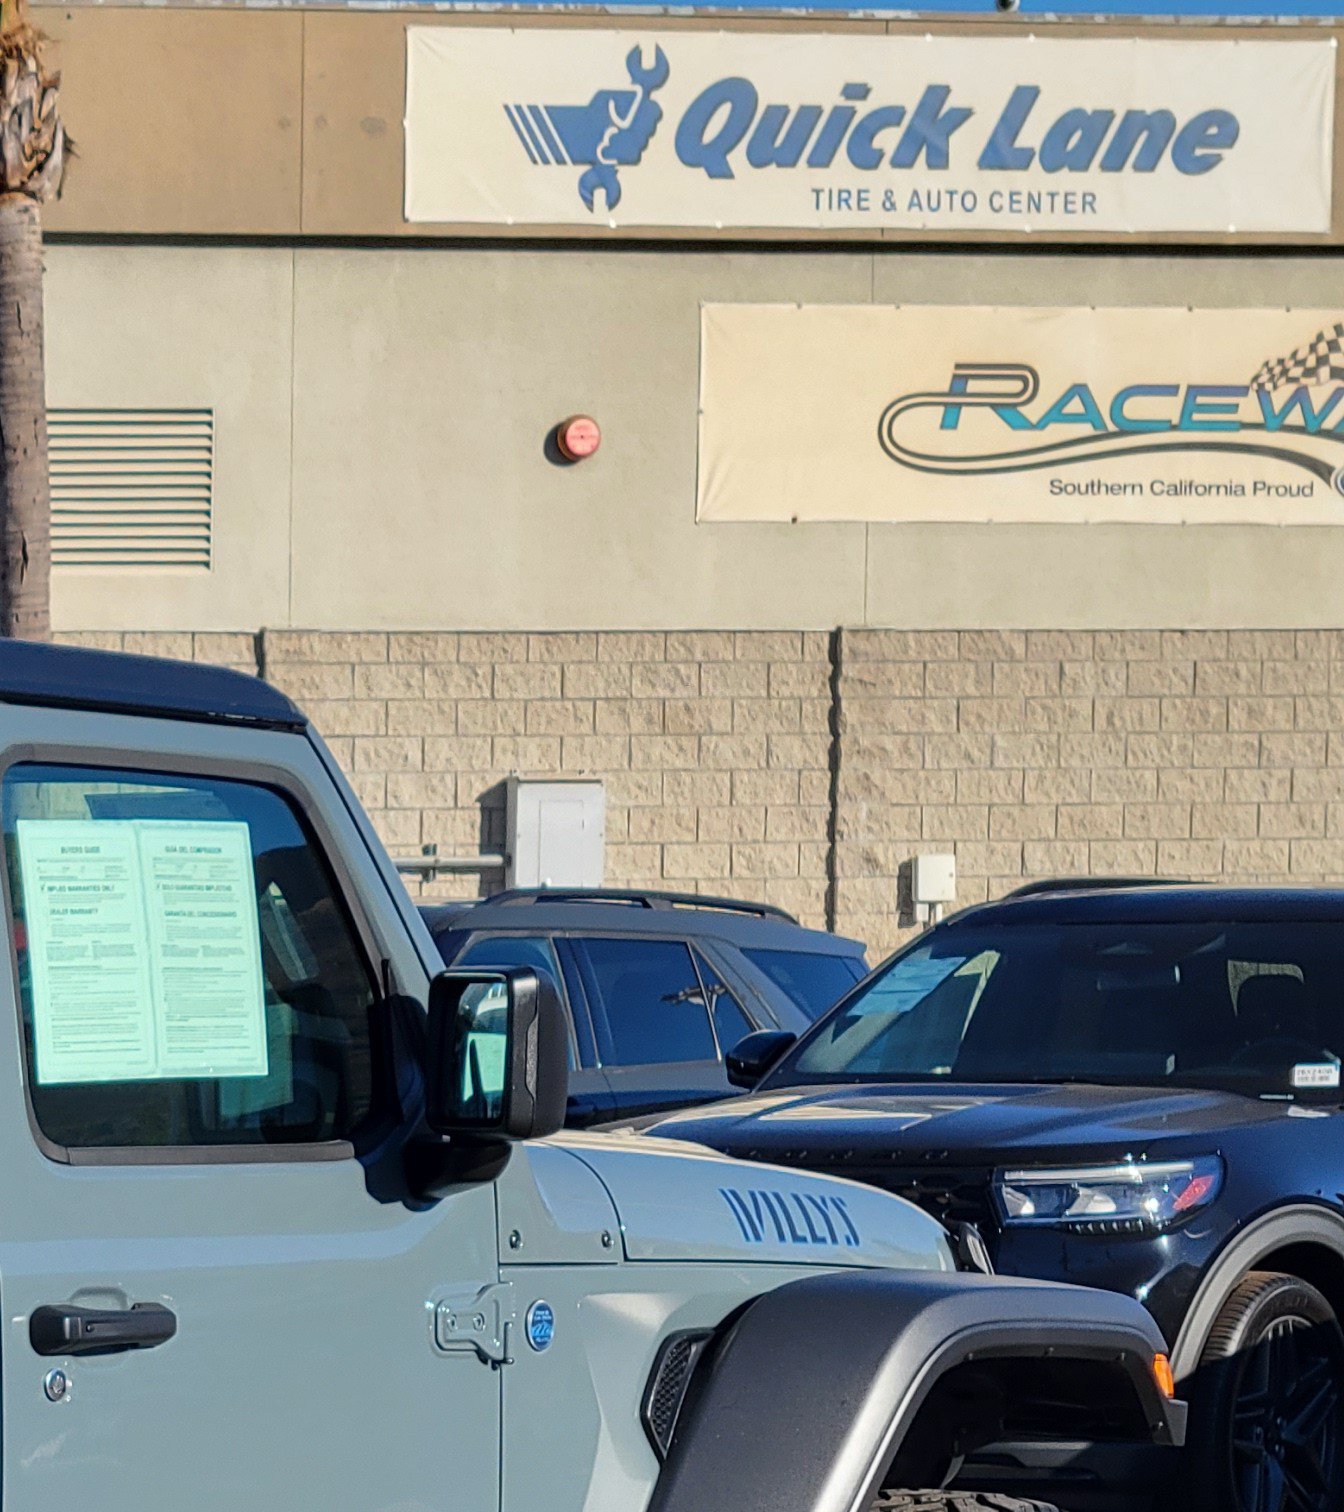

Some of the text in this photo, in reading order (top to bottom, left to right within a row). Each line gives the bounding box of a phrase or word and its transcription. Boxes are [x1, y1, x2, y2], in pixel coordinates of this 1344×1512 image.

[674, 76, 1239, 179] Quick Lane
[812, 187, 1098, 214] TIRE & AUTO CENTER
[939, 362, 1344, 432] RACEW
[1049, 478, 1314, 498] Southern California Proud
[718, 1188, 860, 1247] WILLYS
